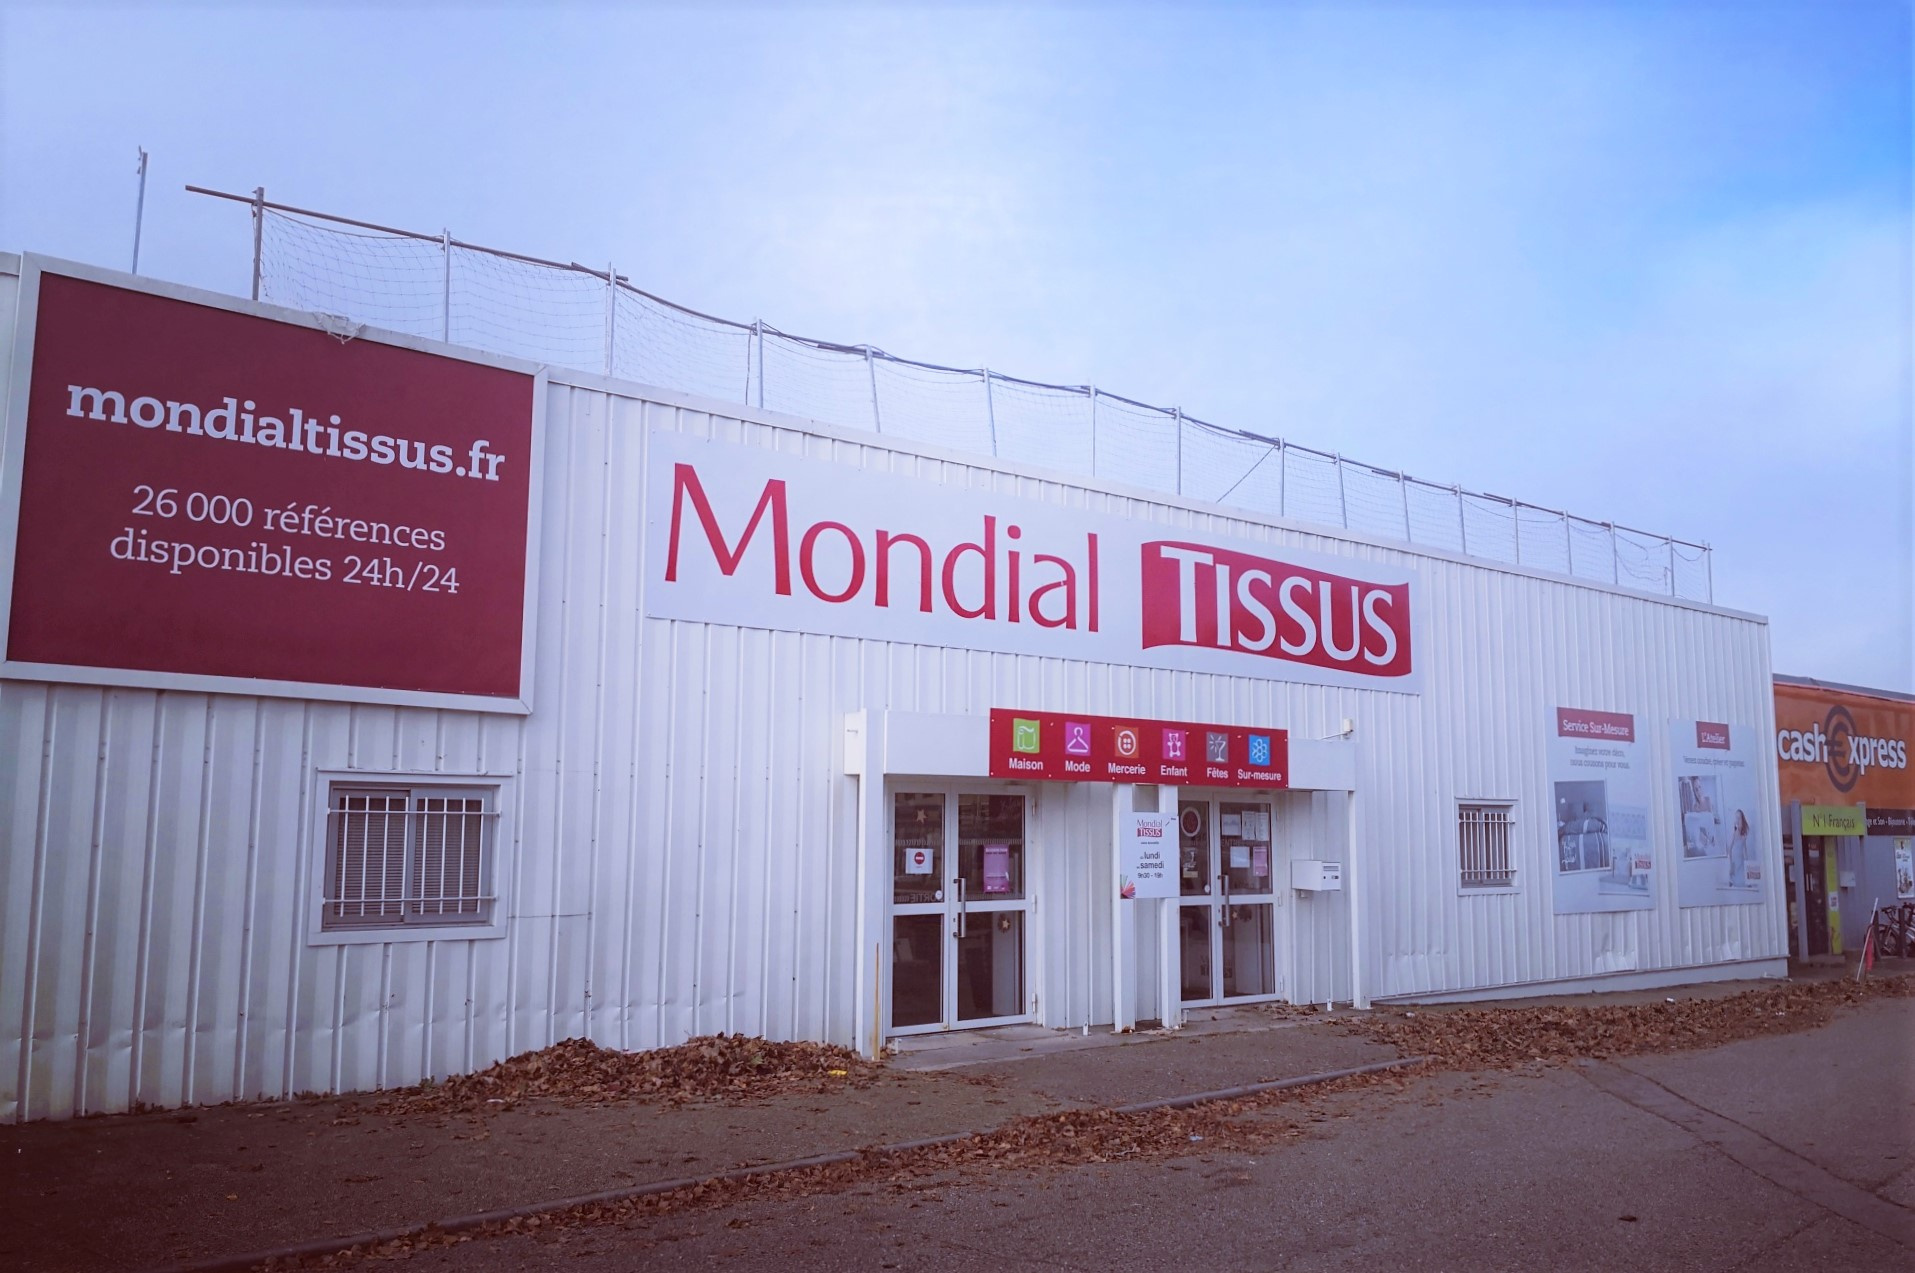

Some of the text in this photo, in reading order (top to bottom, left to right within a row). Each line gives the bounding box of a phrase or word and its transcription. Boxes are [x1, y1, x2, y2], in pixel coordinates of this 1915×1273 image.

[66, 384, 506, 482] mondialtissus.fr
[132, 485, 446, 551] 26 000 références
[110, 527, 460, 594] disponibles 24h/24
[664, 462, 1399, 667] Mondial TISSUS
[1563, 719, 1630, 736] Service Sur-Mesure
[1701, 732, 1726, 744] L'Atelier
[1777, 723, 1828, 763] cash
[1008, 757, 1043, 771] Maison
[1065, 760, 1090, 773] Mode
[1108, 763, 1146, 775] Mercerie
[1160, 765, 1188, 777] Enfant
[1207, 767, 1229, 779] Fêtes
[1237, 768, 1282, 781] Sur-mesure
[1829, 814, 1855, 831] Français
[1138, 828, 1161, 837] TISSUS
[1144, 851, 1161, 860] lundi
[1141, 861, 1164, 869] samedi
